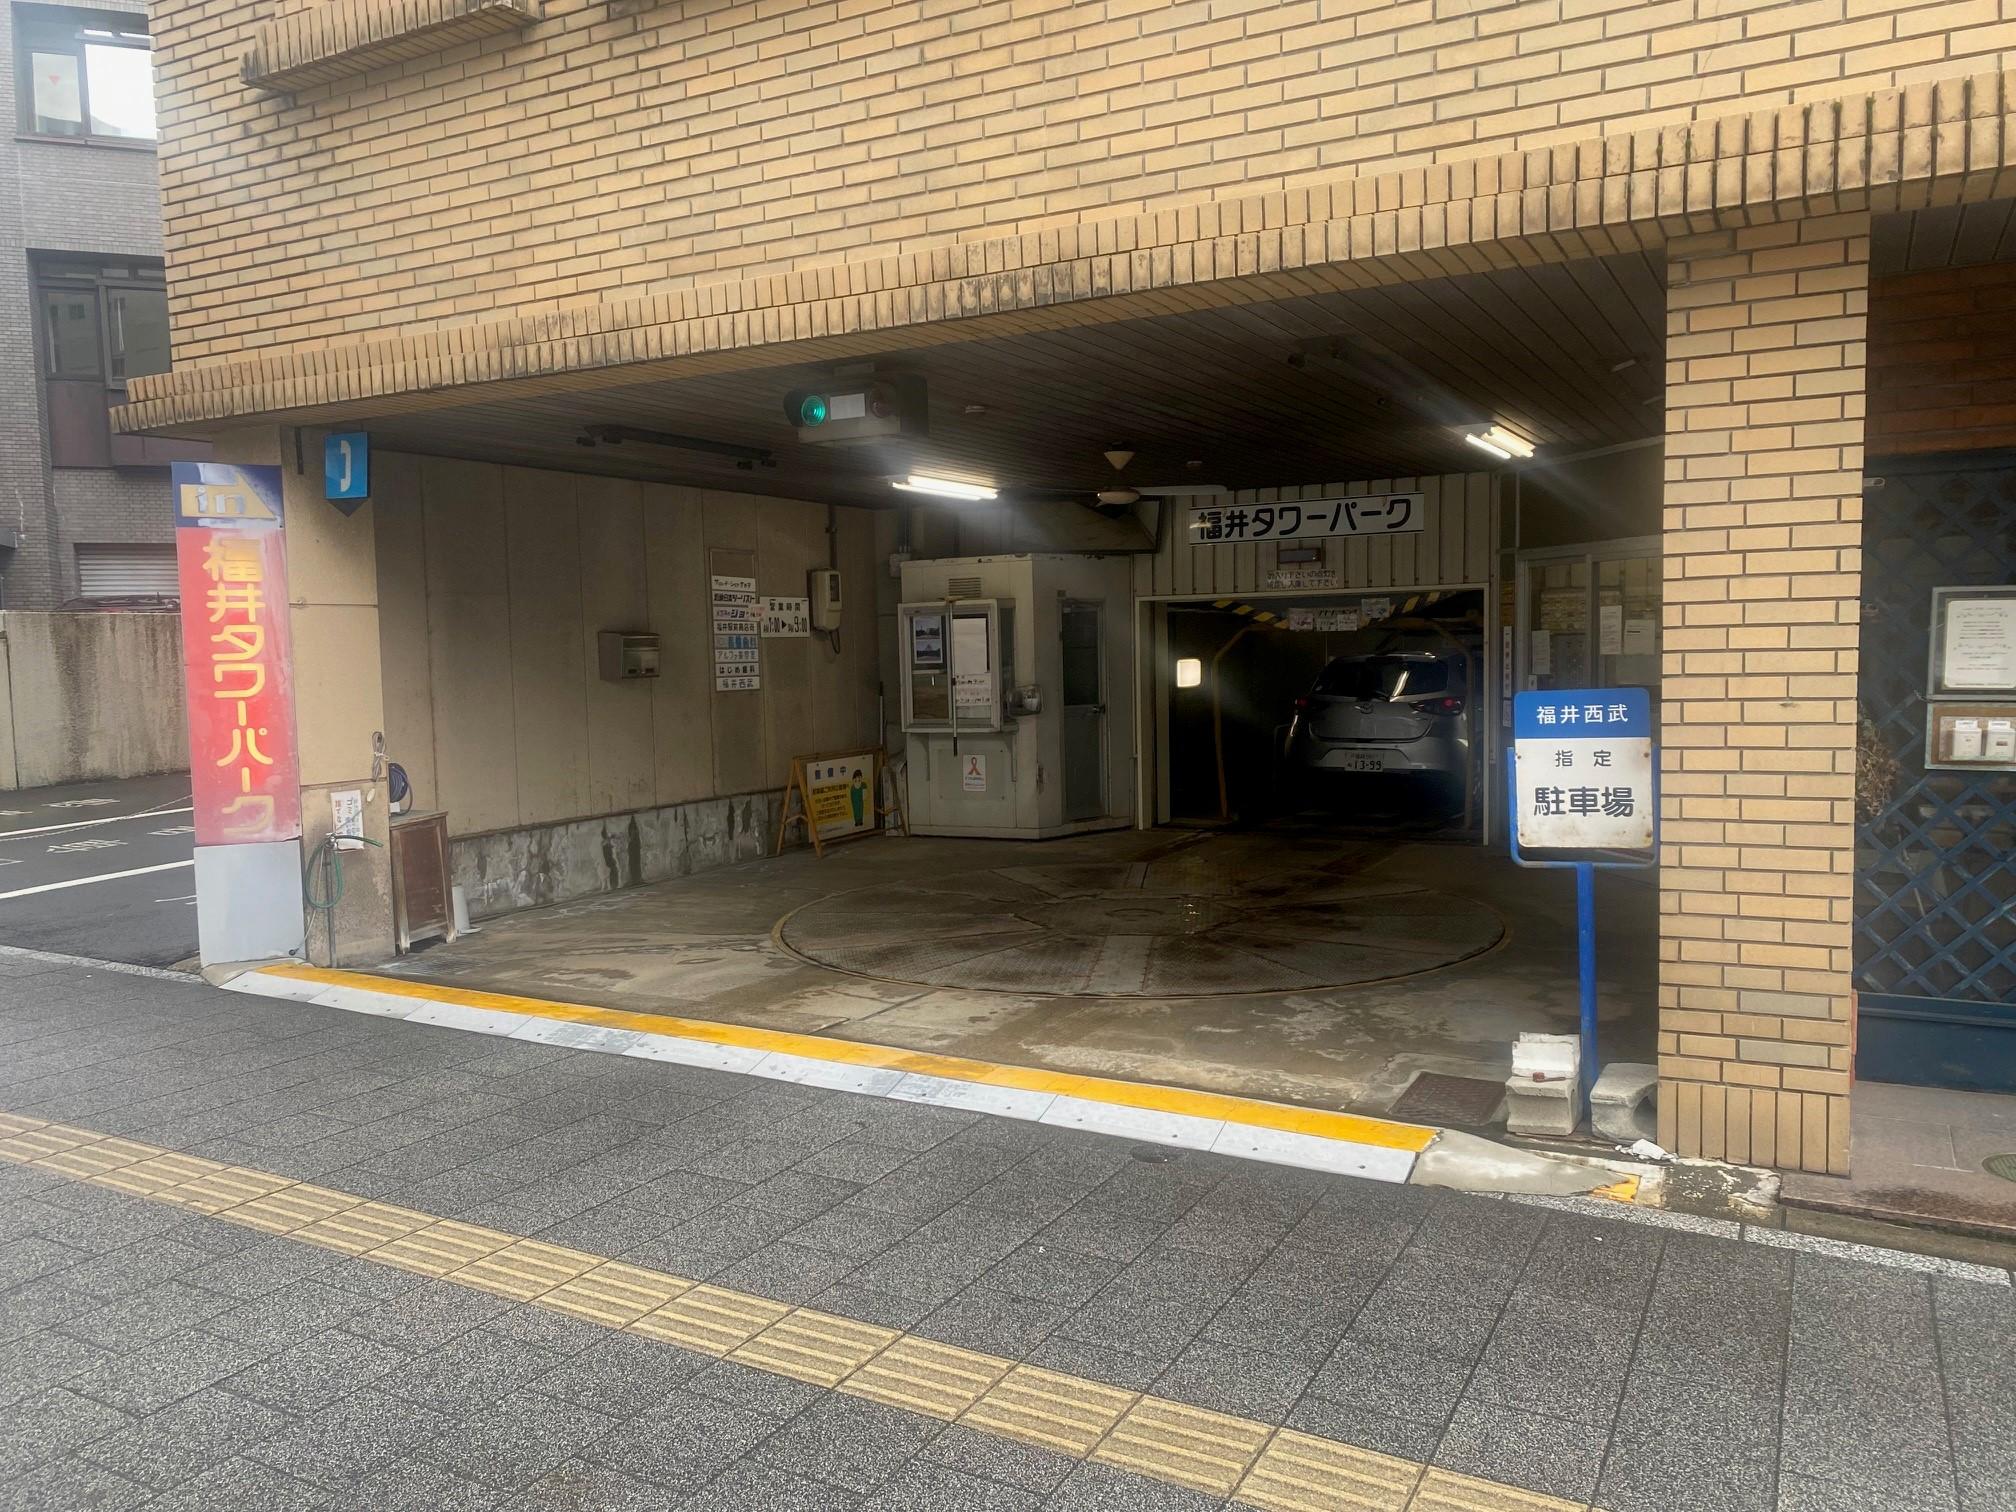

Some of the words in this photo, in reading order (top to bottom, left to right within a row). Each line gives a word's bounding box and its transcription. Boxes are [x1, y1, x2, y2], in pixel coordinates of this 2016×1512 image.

[196, 484, 248, 515] in
[1198, 497, 1413, 541] 福井タワーパーク
[769, 601, 801, 612] 営業時間
[202, 533, 274, 834] 福井タワーパーク
[722, 678, 755, 689] 福井西武
[1536, 703, 1629, 725] 福井西武
[1533, 785, 1635, 818] 駐車場
